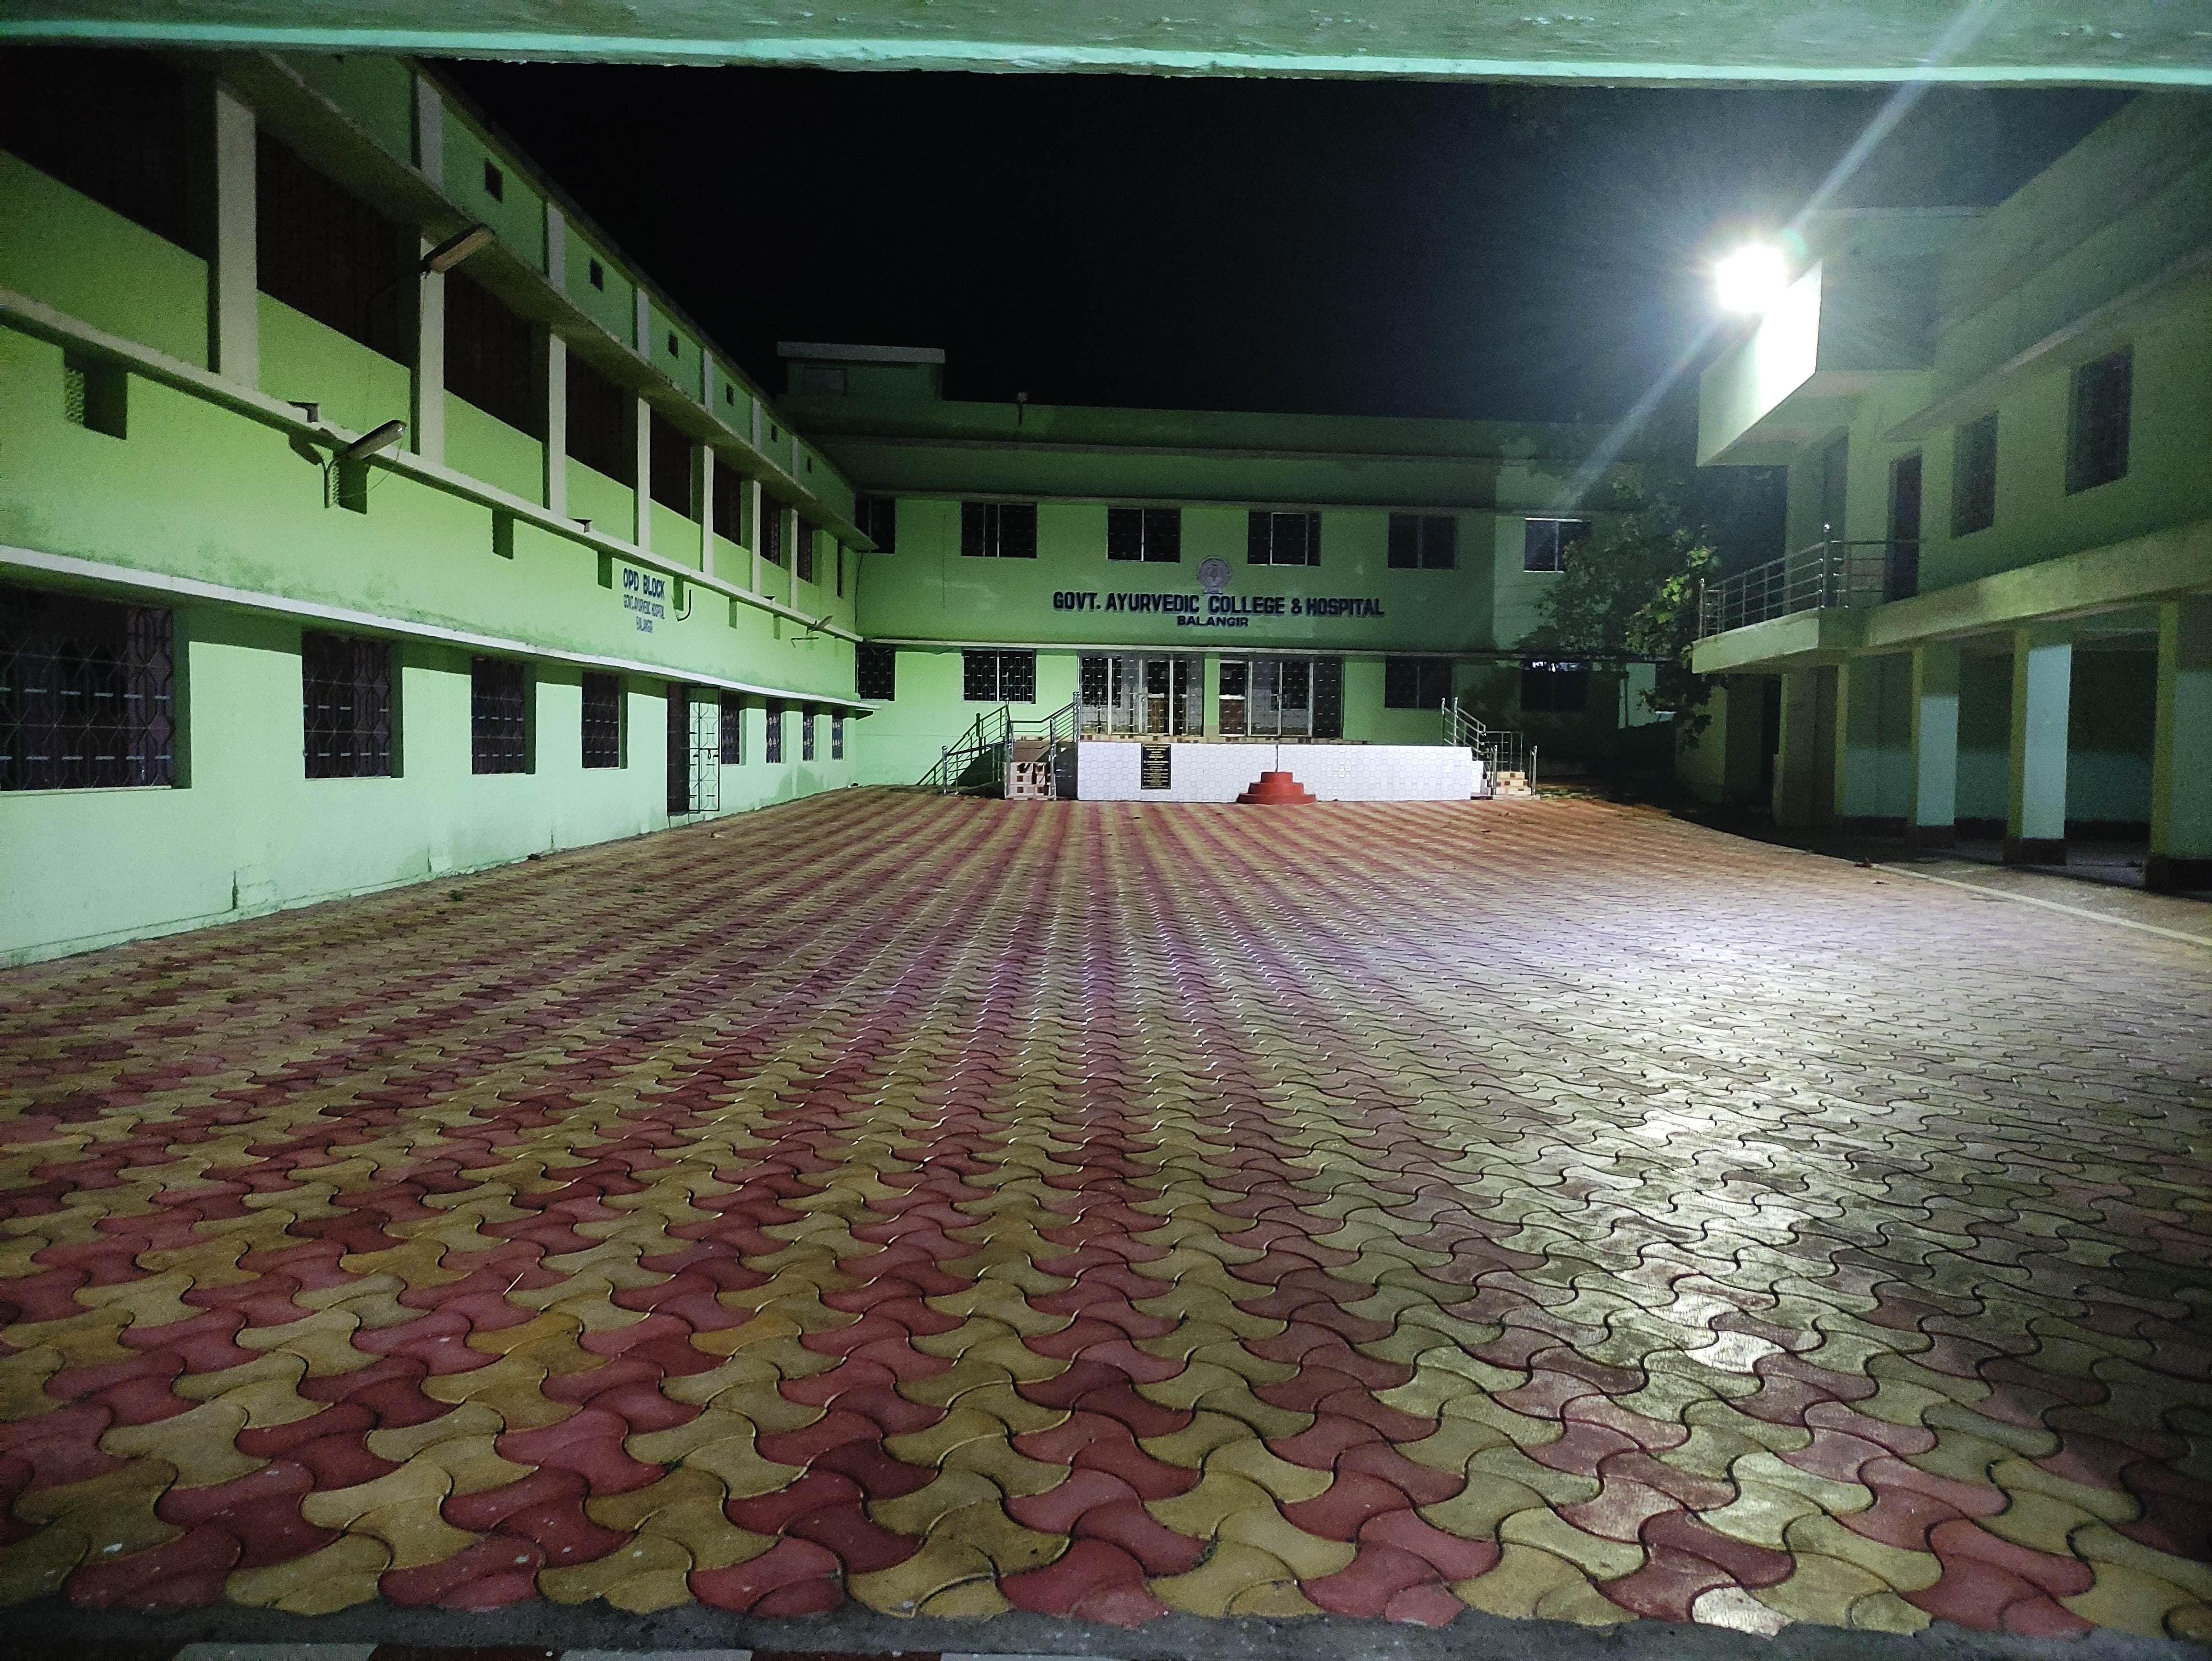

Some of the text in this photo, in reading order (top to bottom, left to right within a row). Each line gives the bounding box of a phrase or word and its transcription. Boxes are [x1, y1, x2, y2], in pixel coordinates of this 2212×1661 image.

[623, 567, 665, 598] OPD BLOCK
[1053, 591, 1384, 616] GOVT. AYURVEDIC COLLEGE & HOSPITAL
[1177, 615, 1249, 627] BALANGIR
